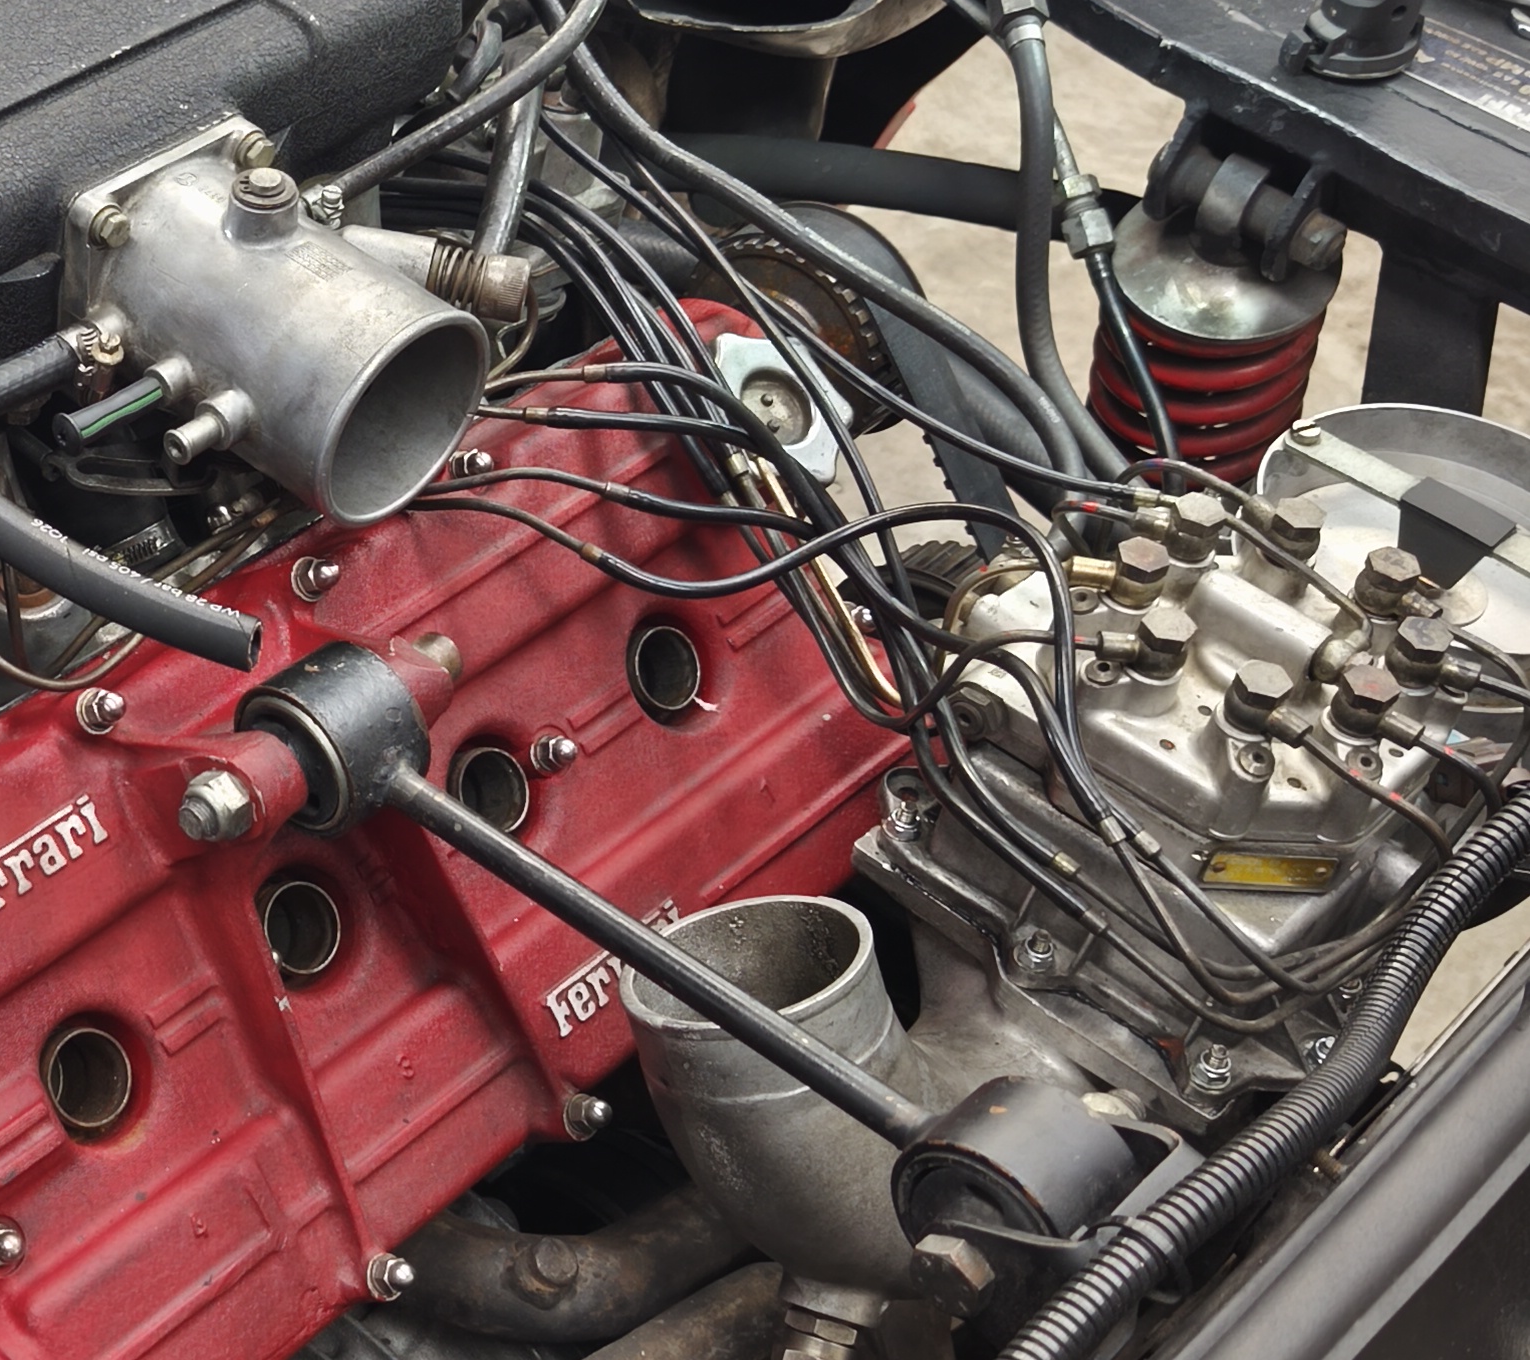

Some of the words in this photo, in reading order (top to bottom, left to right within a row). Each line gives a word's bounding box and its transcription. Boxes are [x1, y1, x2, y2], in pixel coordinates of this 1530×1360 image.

[30, 518, 68, 544] 1026
[109, 561, 142, 578] 405
[153, 582, 183, 599] bar
[184, 594, 209, 607] 28
[210, 603, 240, 619] WP
